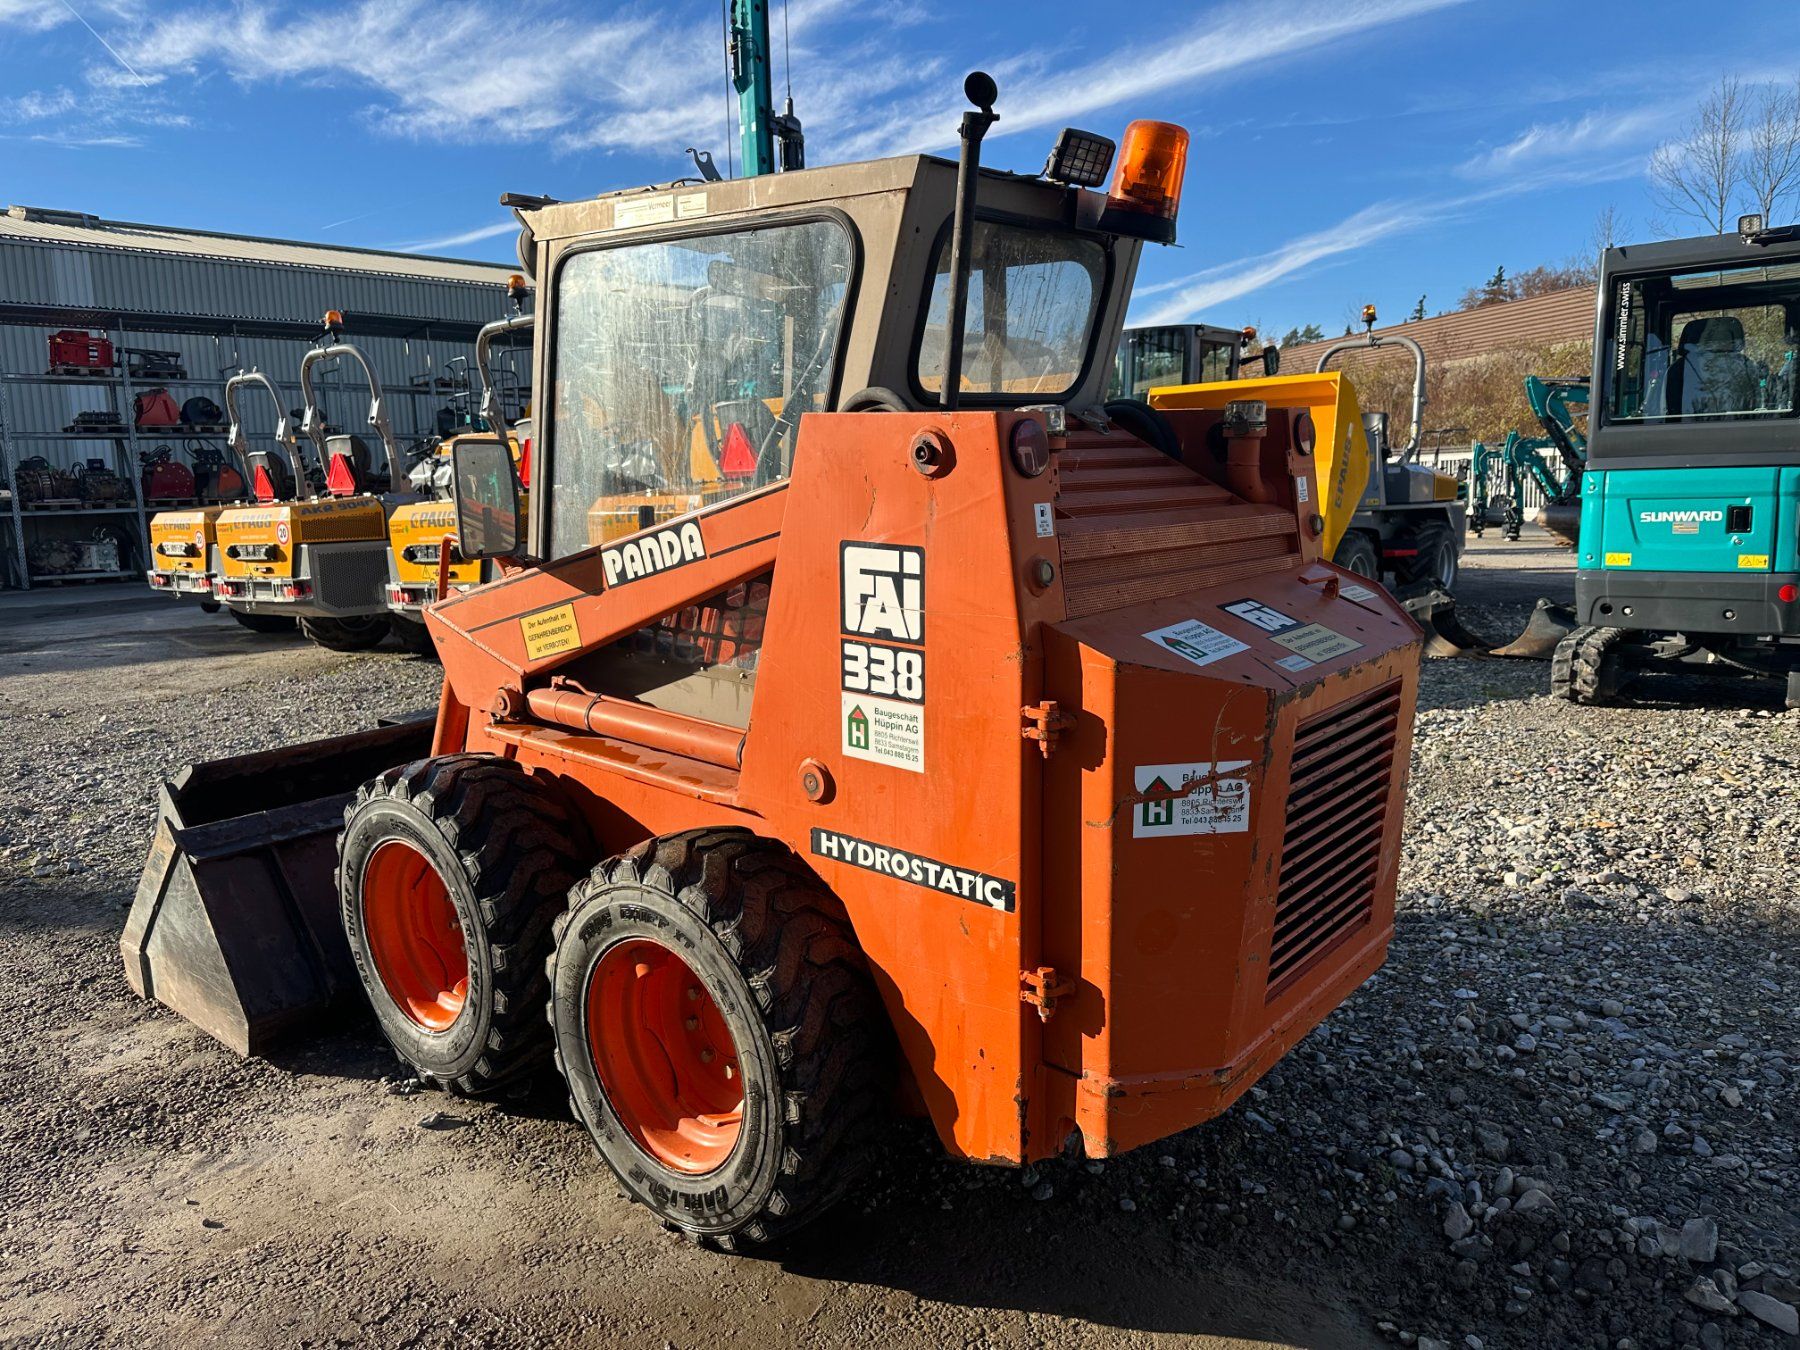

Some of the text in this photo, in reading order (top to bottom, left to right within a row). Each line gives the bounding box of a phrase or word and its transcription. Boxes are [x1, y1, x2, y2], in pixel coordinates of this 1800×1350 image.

[1617, 282, 1631, 371] www.simmler.swiss
[1640, 511, 1723, 523] SUNWARD
[279, 528, 287, 540] 20
[602, 523, 705, 586] PANDA
[528, 624, 573, 642] GEFAHRENBEREICH
[844, 643, 922, 700] 338
[874, 707, 919, 723] Baugeschäft
[874, 717, 919, 734] Hüppin AG
[874, 730, 919, 746] 8805 Richterswil
[874, 738, 919, 754] 8833 Samstagern
[874, 746, 883, 754] Tel
[884, 748, 894, 757] 043
[894, 751, 905, 759] 888
[912, 755, 919, 763] 25
[1193, 816, 1207, 824] 043
[1232, 814, 1242, 822] 25
[820, 832, 1006, 911] HYDROSTATIC
